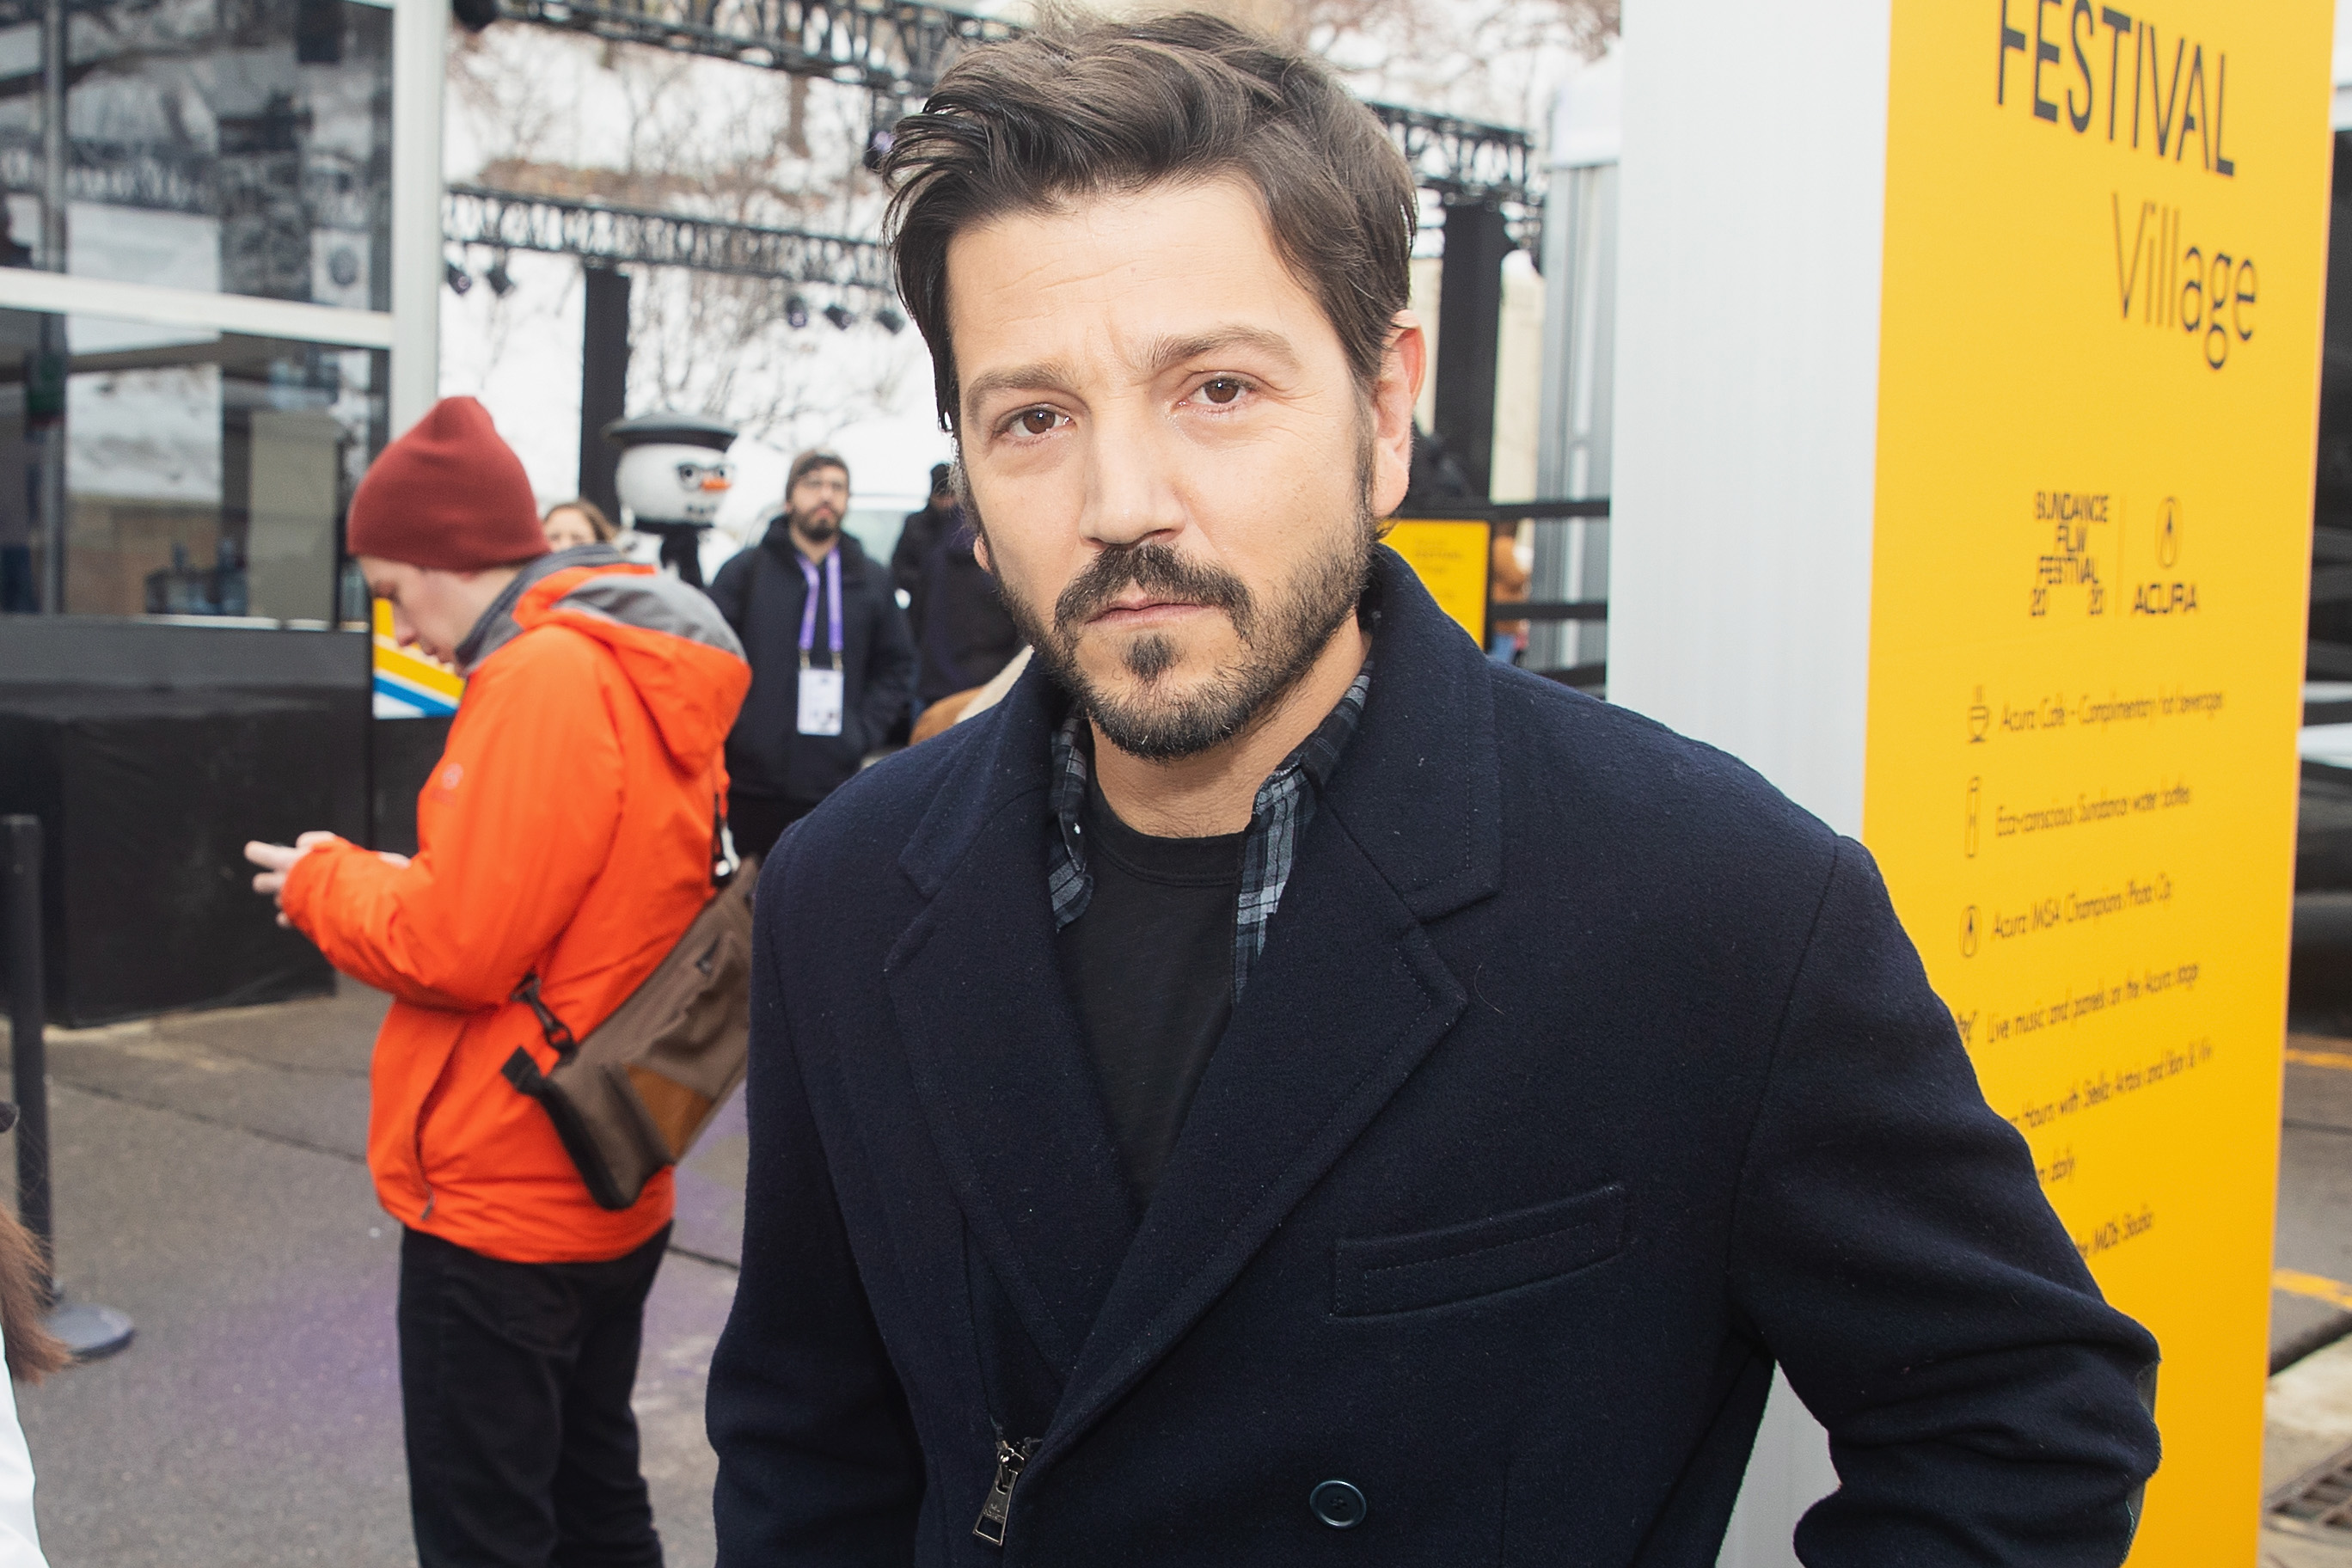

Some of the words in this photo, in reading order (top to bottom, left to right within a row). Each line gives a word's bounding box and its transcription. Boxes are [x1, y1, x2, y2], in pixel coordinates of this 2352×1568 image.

[1996, 0, 2235, 178] FESTIVAL
[2111, 192, 2257, 371] Village
[2035, 490, 2110, 523] SUNDANCE
[2055, 524, 2089, 553] FILM
[2037, 555, 2100, 585] FESTIVAL
[2130, 583, 2199, 616] ACURA
[2000, 703, 2036, 732] Acura
[1991, 909, 2027, 940] Acura
[1988, 1012, 2009, 1043] Live
[2014, 1001, 2044, 1035] music
[2049, 987, 2070, 1025] and
[2144, 969, 2171, 993] Acura
